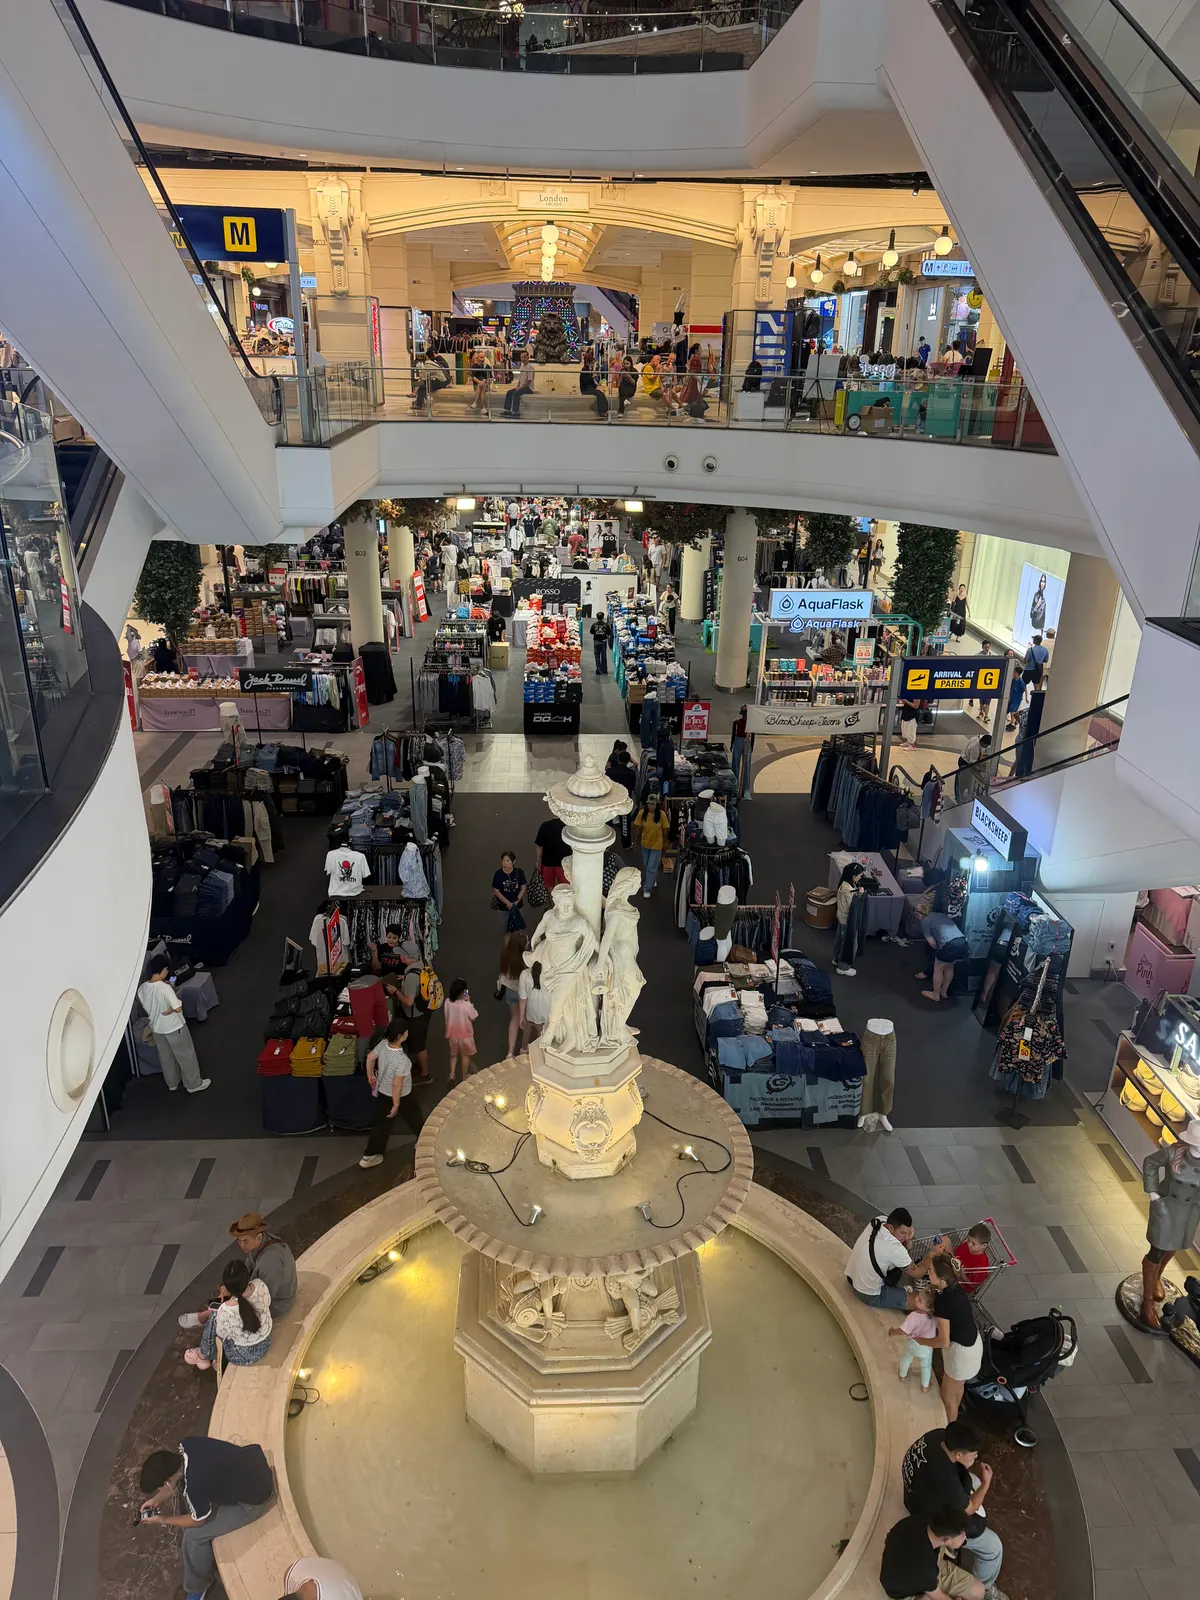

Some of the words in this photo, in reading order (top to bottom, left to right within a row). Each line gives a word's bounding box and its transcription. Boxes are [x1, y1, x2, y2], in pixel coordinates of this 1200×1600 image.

[539, 194, 568, 203] London
[229, 222, 250, 246] M
[797, 598, 864, 613] AquaFlask
[805, 619, 860, 630] AquaFlask
[933, 670, 963, 678] ARRIVAL
[966, 670, 975, 678] AT
[983, 671, 994, 686] G
[940, 679, 965, 688] PARIS
[975, 805, 1009, 844] BLACKSHEEP
[1174, 1021, 1200, 1065] SA
